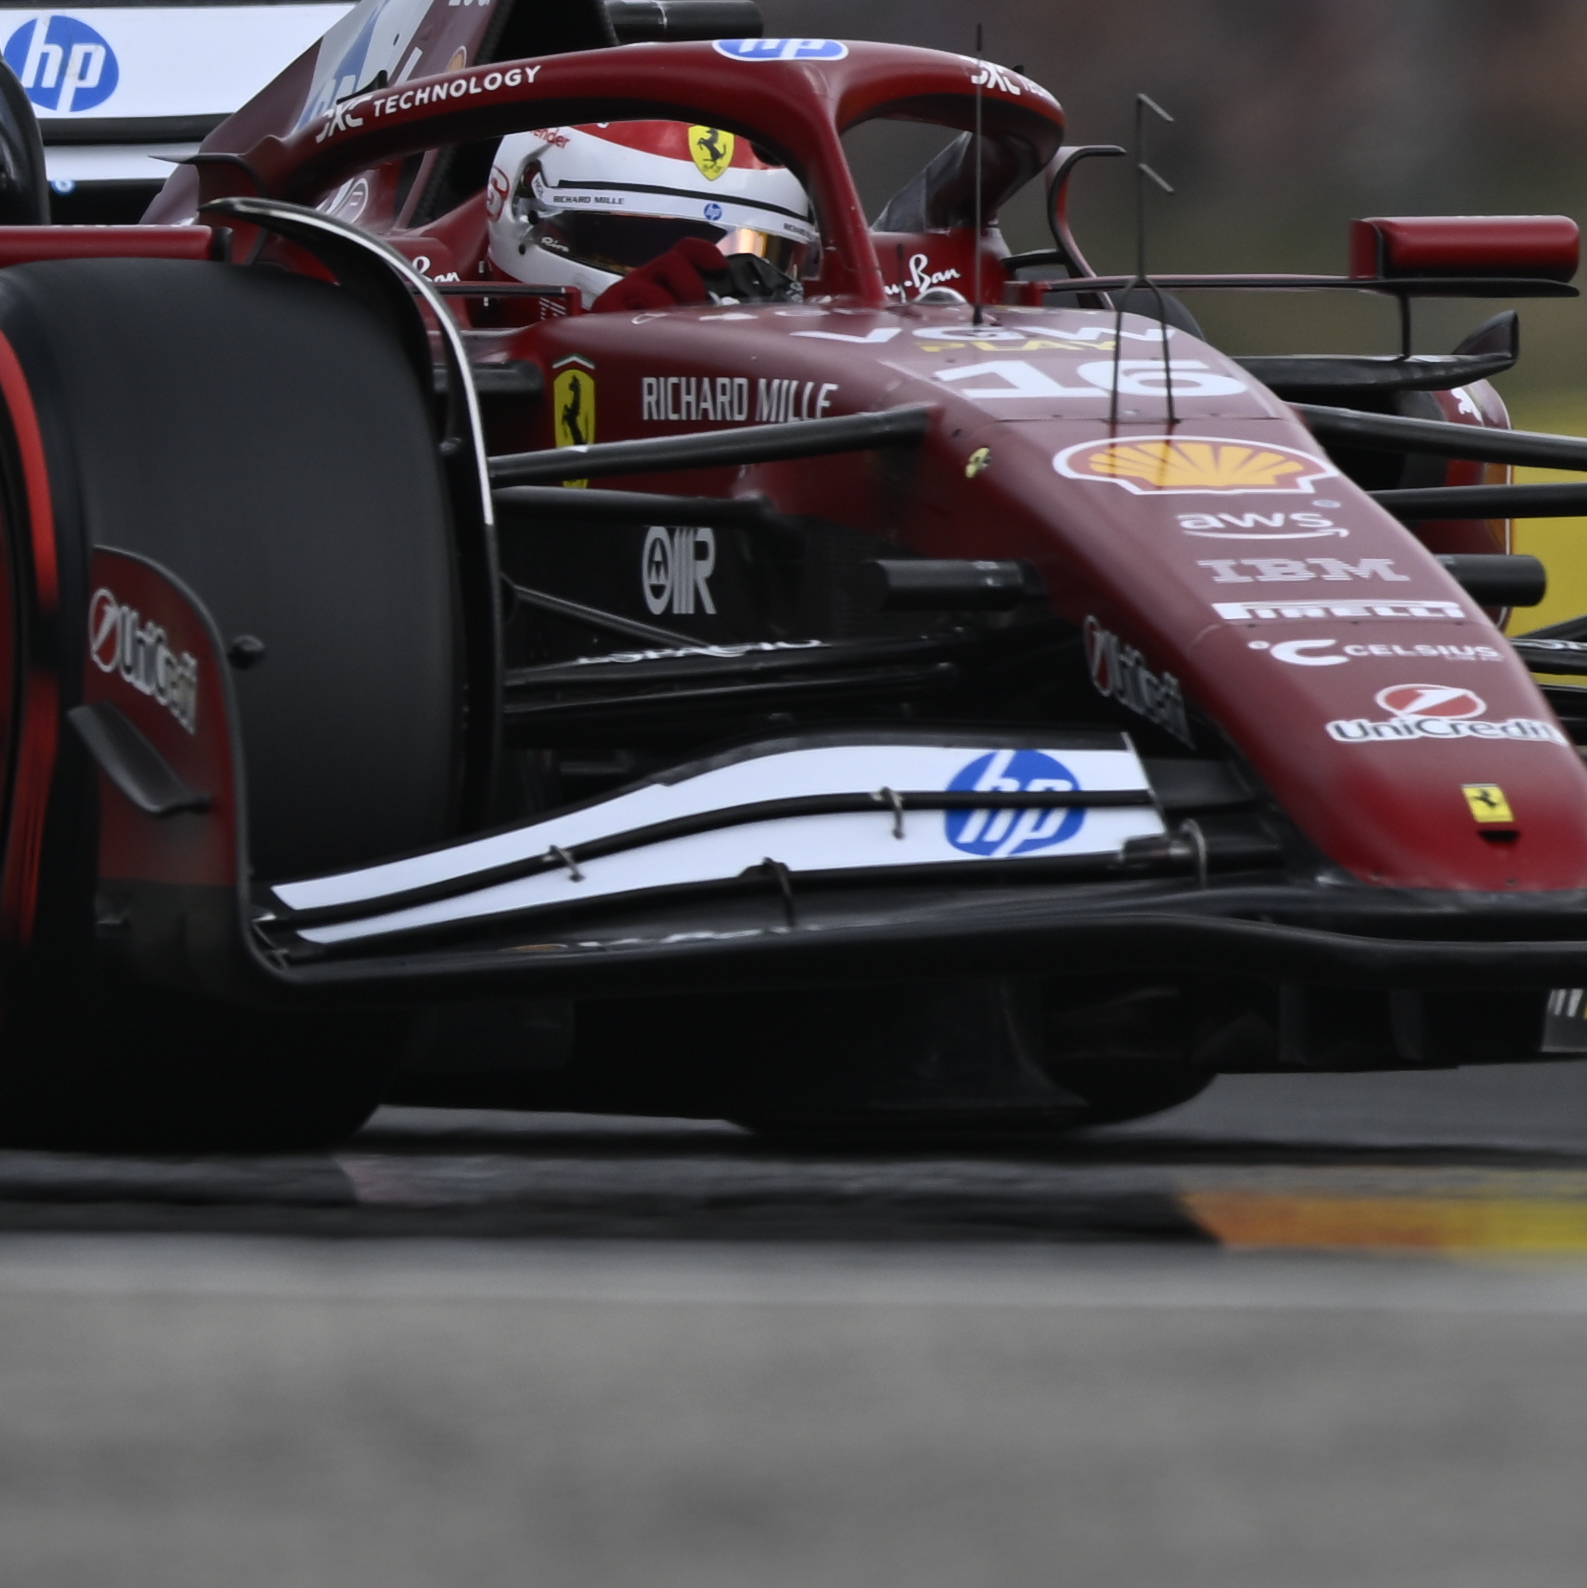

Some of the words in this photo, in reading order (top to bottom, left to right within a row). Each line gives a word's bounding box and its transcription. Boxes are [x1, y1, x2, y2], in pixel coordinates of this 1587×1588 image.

[11, 15, 113, 112] hp
[373, 65, 542, 117] TECHNOLOGY
[553, 195, 591, 204] RICHARD
[594, 196, 624, 205] MILLE
[917, 340, 1119, 353] PLAY
[934, 360, 1249, 399] 16
[642, 377, 749, 421] RICHARD
[755, 378, 839, 424] MILLE
[1178, 512, 1336, 532] aws
[1197, 558, 1409, 583] IBM
[1211, 599, 1465, 620] PIRELLI
[1343, 644, 1499, 658] CELSIUS
[952, 749, 1081, 857] hp
